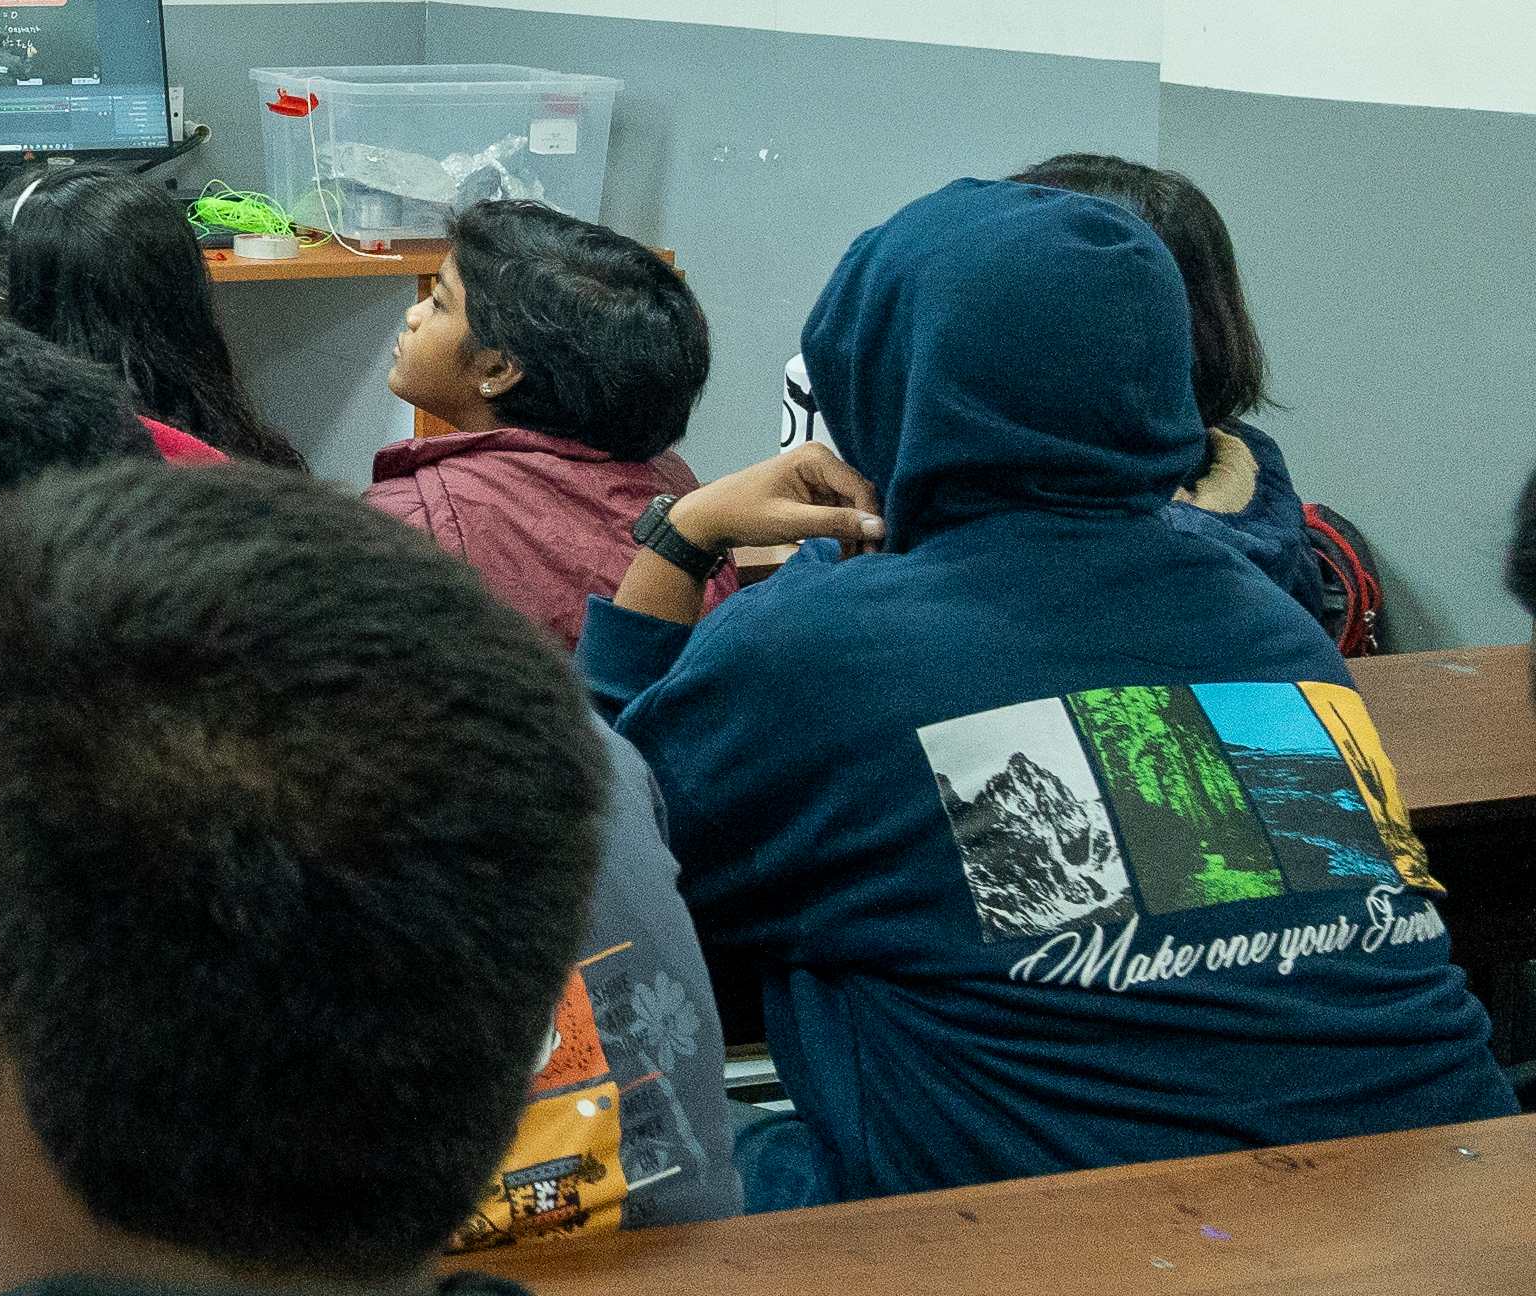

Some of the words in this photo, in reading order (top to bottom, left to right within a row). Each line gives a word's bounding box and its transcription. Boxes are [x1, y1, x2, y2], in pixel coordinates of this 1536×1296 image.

[1009, 912, 1206, 993] Make
[1206, 930, 1279, 974] one
[1278, 915, 1360, 976] your
